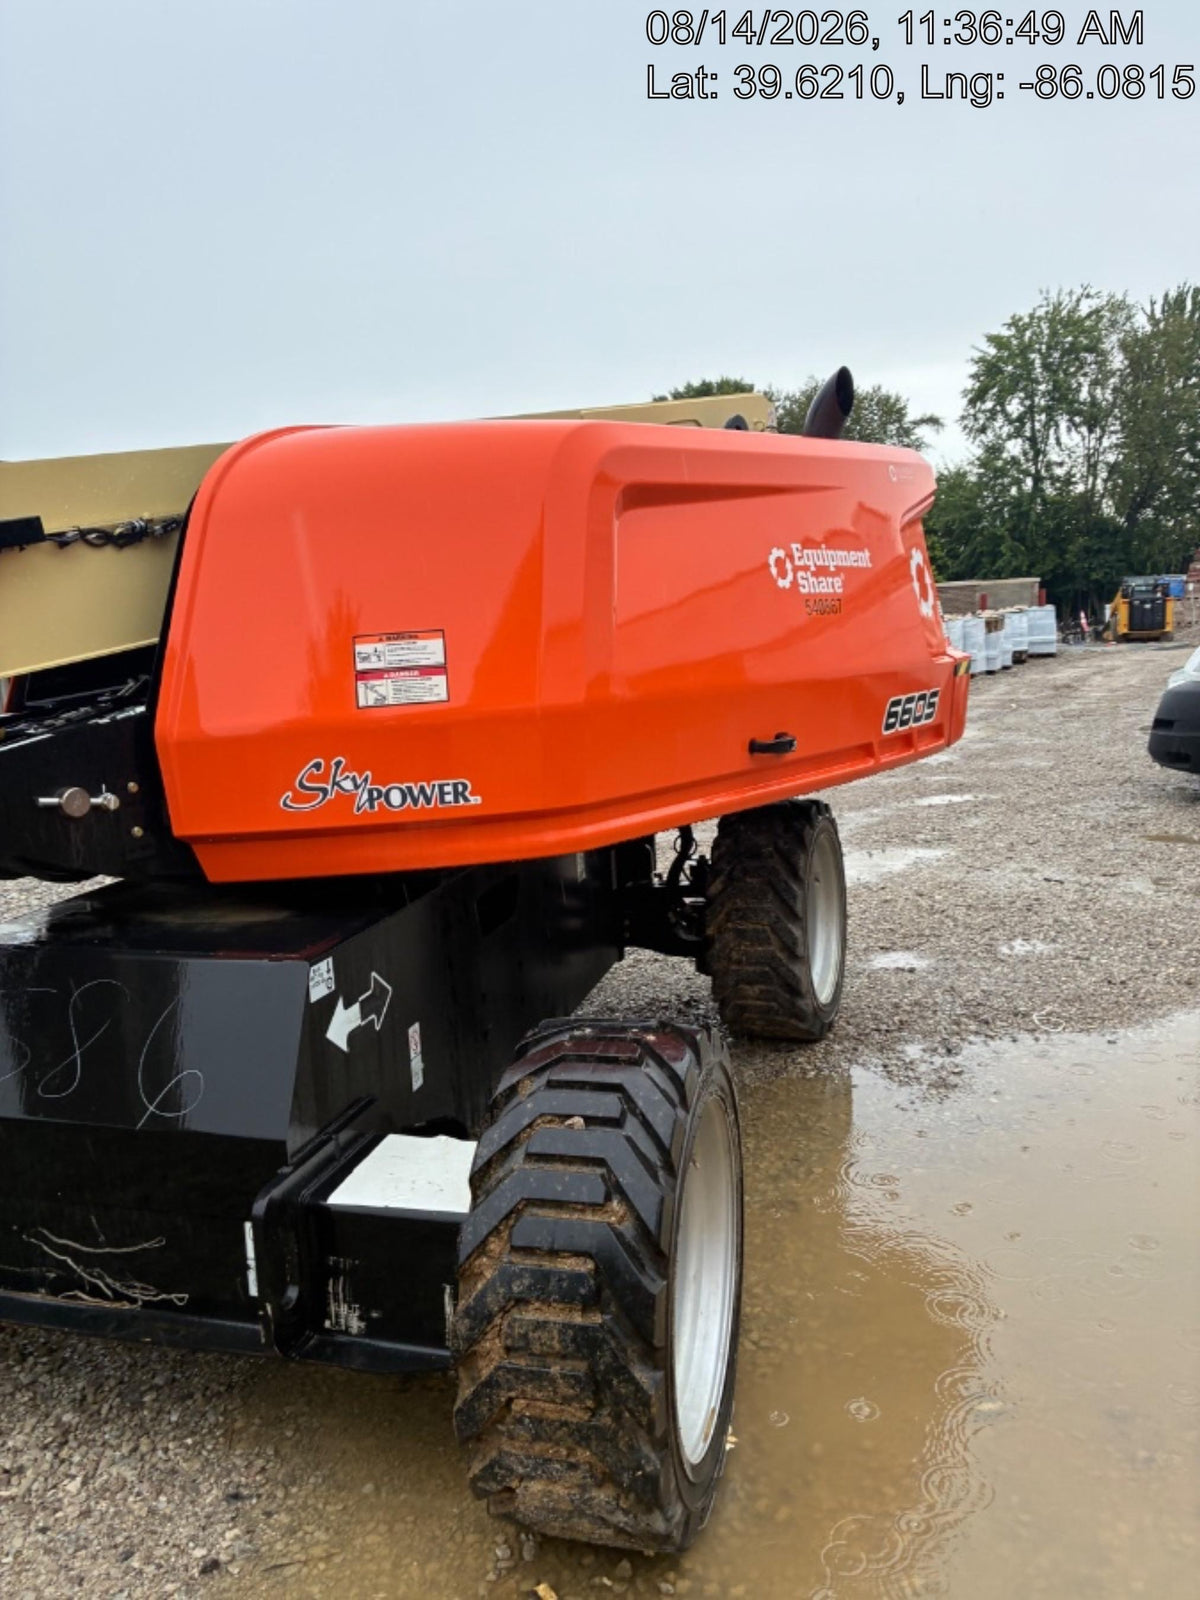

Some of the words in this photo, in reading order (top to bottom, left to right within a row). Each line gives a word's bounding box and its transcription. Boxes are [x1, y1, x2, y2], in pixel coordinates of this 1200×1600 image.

[791, 543, 872, 571] Equipment
[797, 570, 843, 594] Share
[281, 757, 372, 814] Sky
